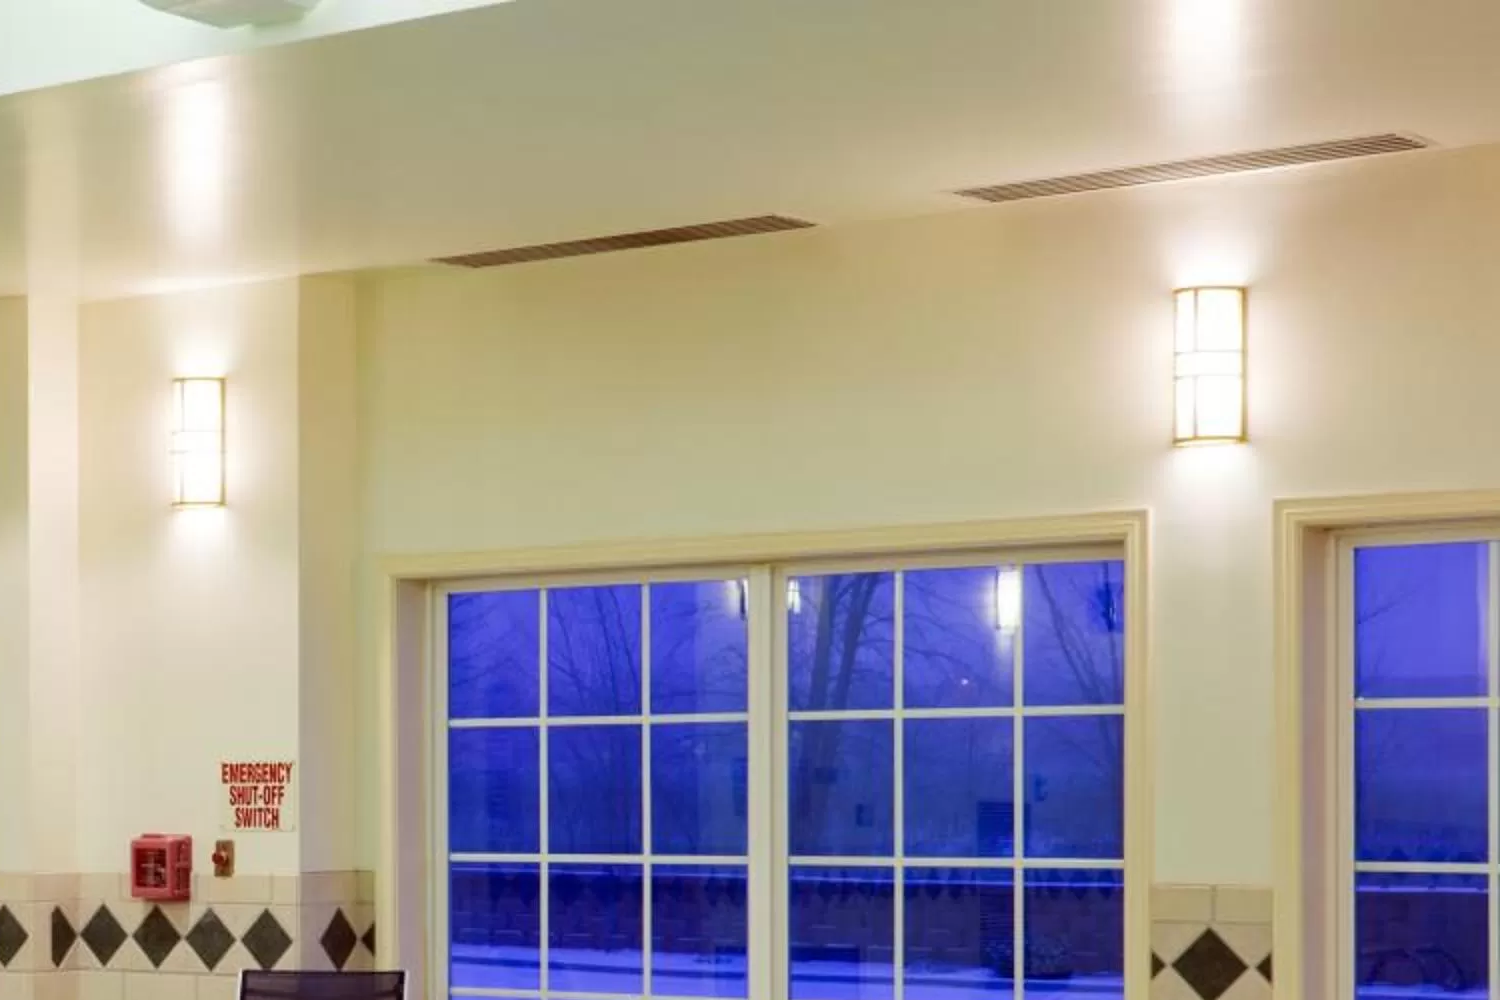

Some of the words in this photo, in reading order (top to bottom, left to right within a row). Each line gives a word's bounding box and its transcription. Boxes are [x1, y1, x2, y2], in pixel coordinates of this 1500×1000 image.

[222, 762, 292, 784] EMERGENCY
[229, 786, 284, 805] SHUT-OFF
[235, 808, 280, 828] SWITCH
